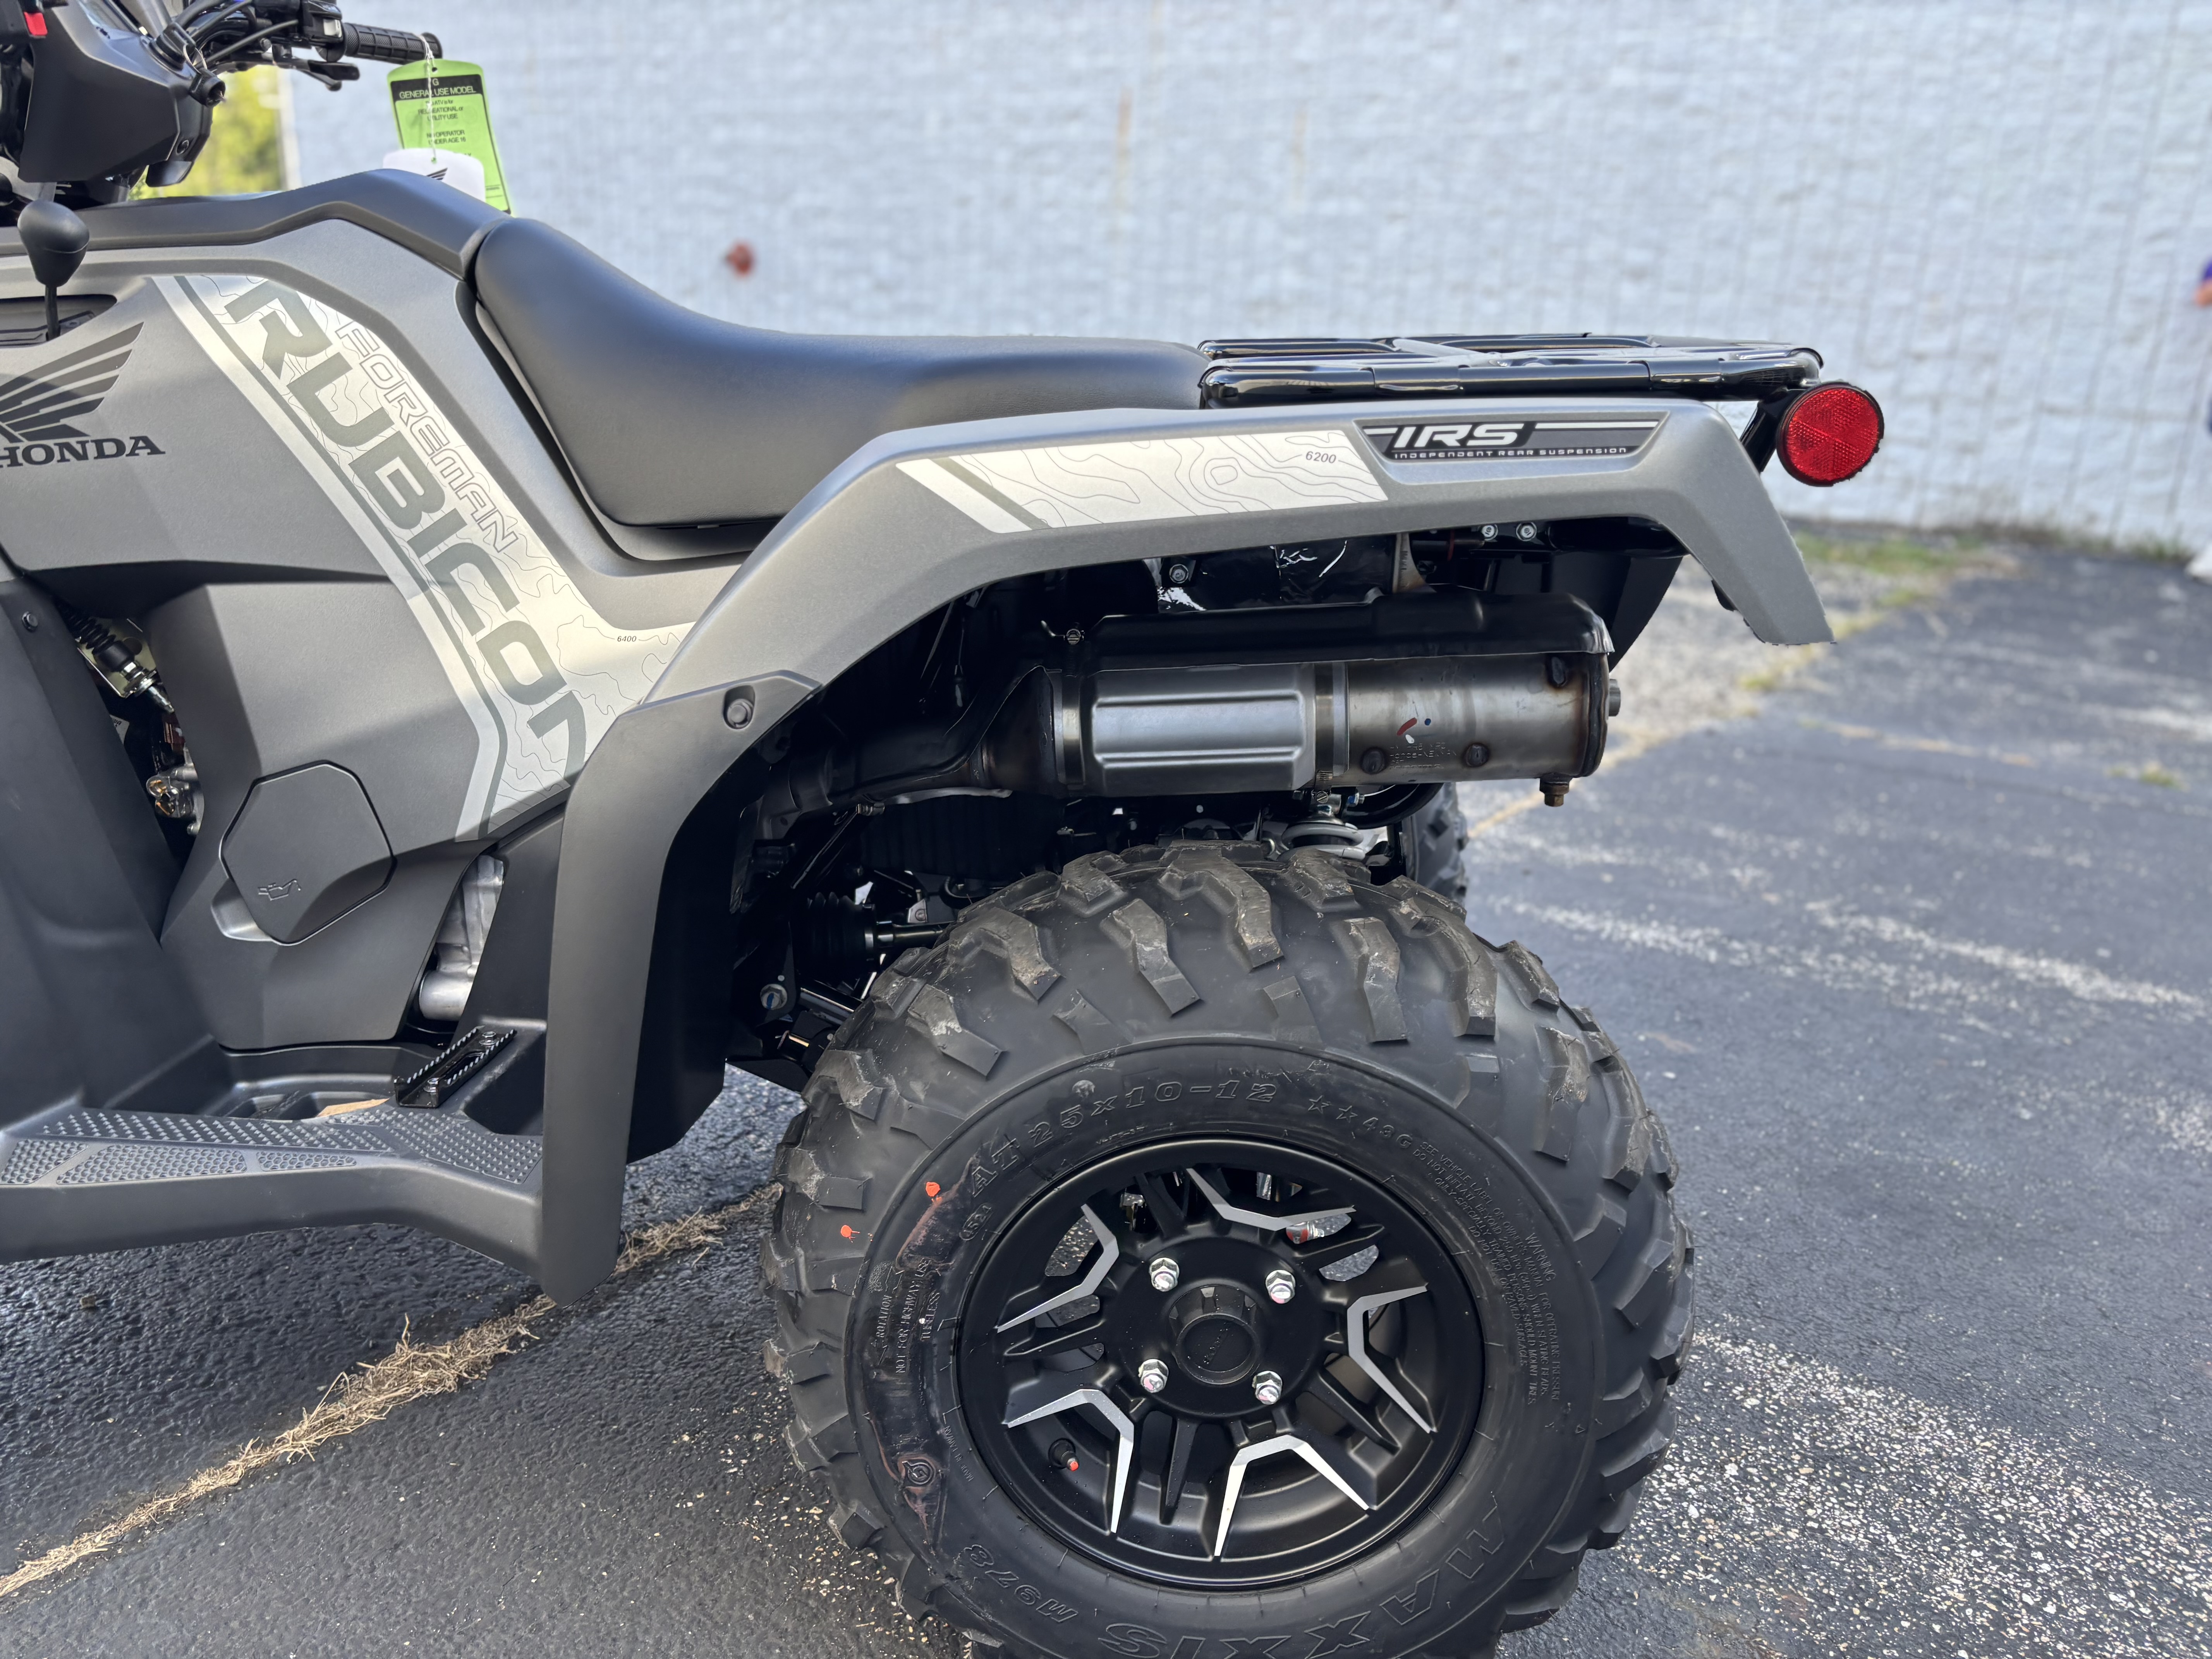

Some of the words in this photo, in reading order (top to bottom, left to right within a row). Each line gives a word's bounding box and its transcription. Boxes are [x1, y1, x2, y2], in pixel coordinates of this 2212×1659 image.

[434, 88, 449, 96] USE
[450, 86, 476, 94] MODEL
[336, 320, 519, 553] FOREMAN
[1394, 423, 1524, 448] IRS
[0, 436, 165, 467] HONDA
[1306, 451, 1336, 464] 6200
[971, 1137, 1021, 1197] AT
[1029, 1080, 1277, 1148] 25x10-12
[1413, 1149, 1427, 1160] DO
[1427, 1159, 1446, 1175] NOT
[1475, 1203, 1502, 1235] BEYOND
[1420, 1141, 1438, 1156] SEE
[1439, 1154, 1471, 1183] VEHICLE
[1492, 1207, 1505, 1219] OR
[1434, 1177, 1456, 1197] ONLY
[915, 1257, 930, 1278] USE
[1468, 1225, 1480, 1237] DO
[1478, 1238, 1492, 1255] NOT
[1499, 1277, 1510, 1289] ON
[1524, 1232, 1556, 1281] WARNING
[876, 1295, 892, 1337] ROTATION
[901, 1281, 921, 1324] HIGHWAY
[898, 1329, 908, 1347] FOR
[896, 1355, 905, 1372] NOT
[943, 1425, 958, 1451] TAIWAN
[954, 1453, 963, 1462] IN
[958, 1463, 974, 1481] MADE
[965, 1543, 1079, 1623] M978
[1097, 1499, 1506, 1659] MAXXIS
